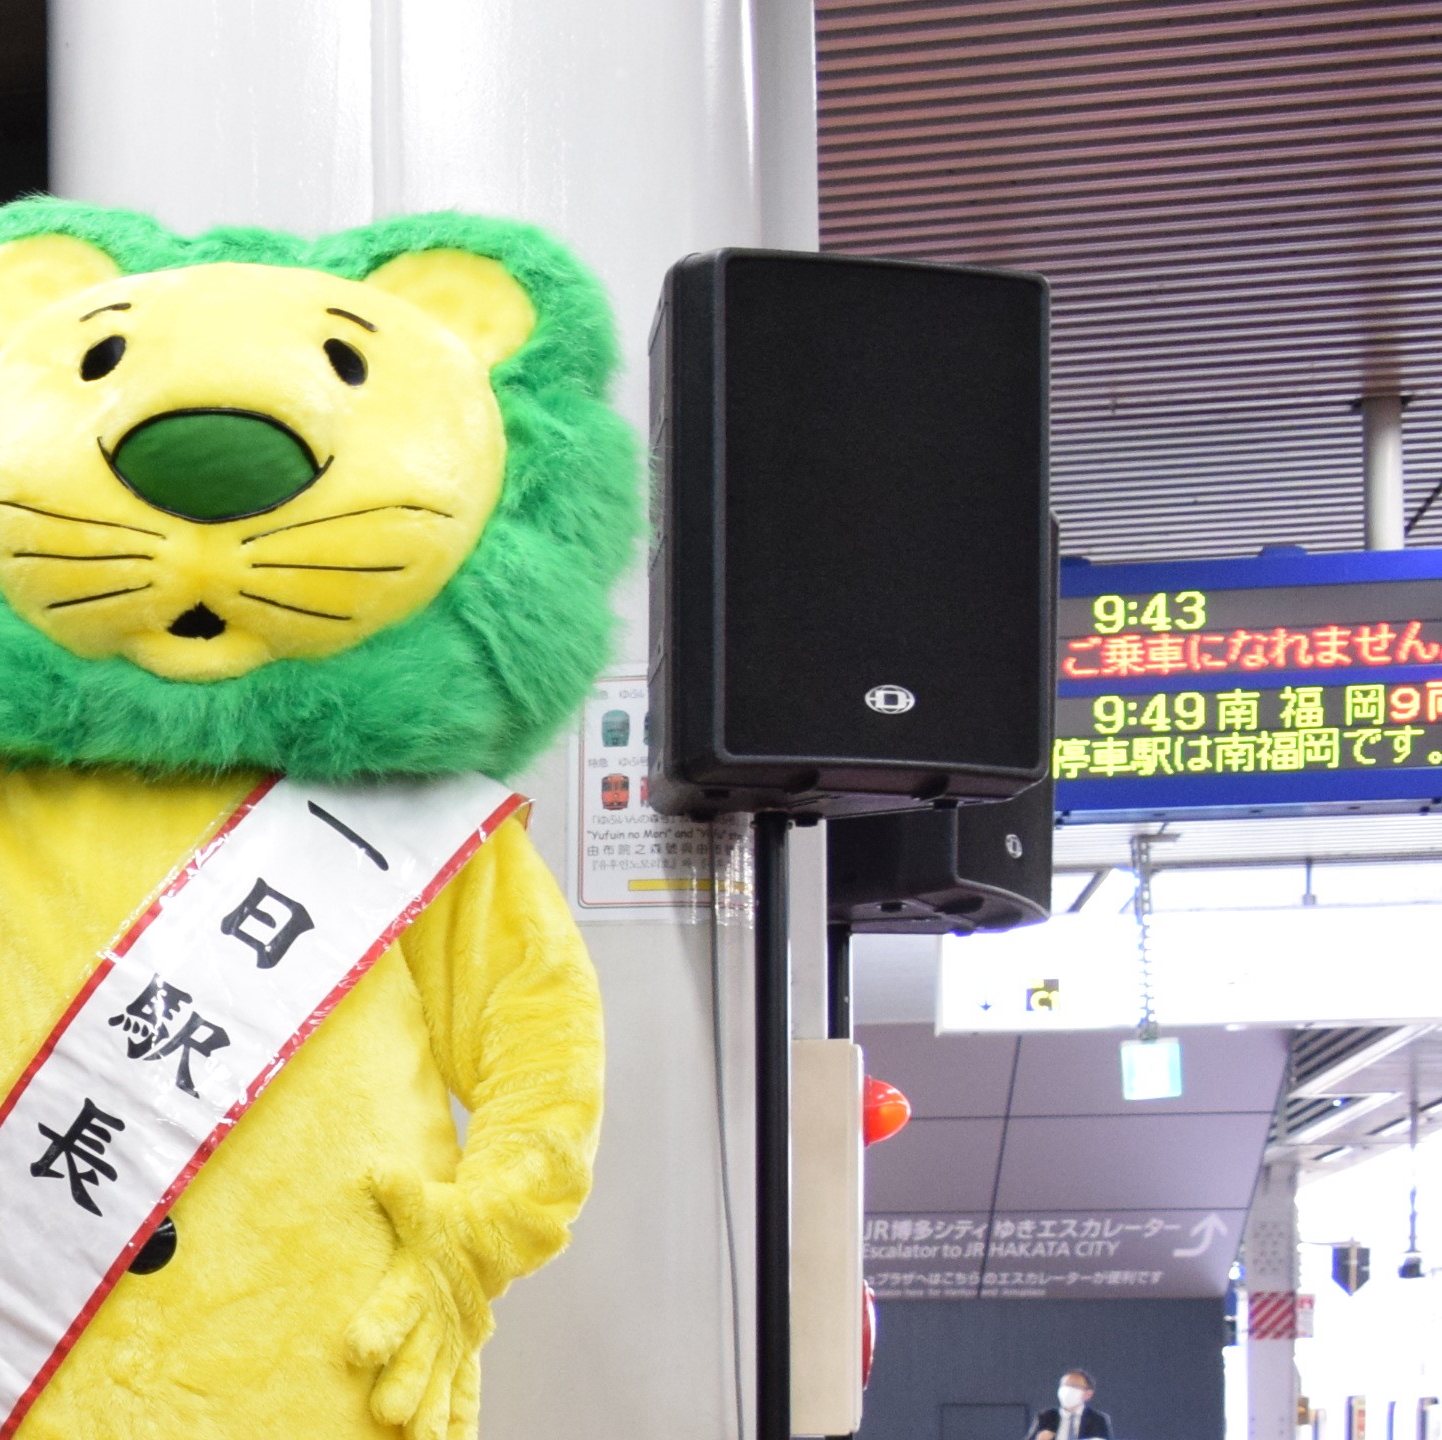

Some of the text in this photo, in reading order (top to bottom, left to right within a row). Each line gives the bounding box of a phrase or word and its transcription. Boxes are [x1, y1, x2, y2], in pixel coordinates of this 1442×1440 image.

[1093, 591, 1207, 634] 9:43
[1093, 691, 1207, 734] 9:49
[1052, 725, 1442, 781] 停車駅は南福岡です。
[29, 799, 390, 1219] 一日駅長
[864, 1240, 1122, 1258] Escalator to JR HAKATA CITY
